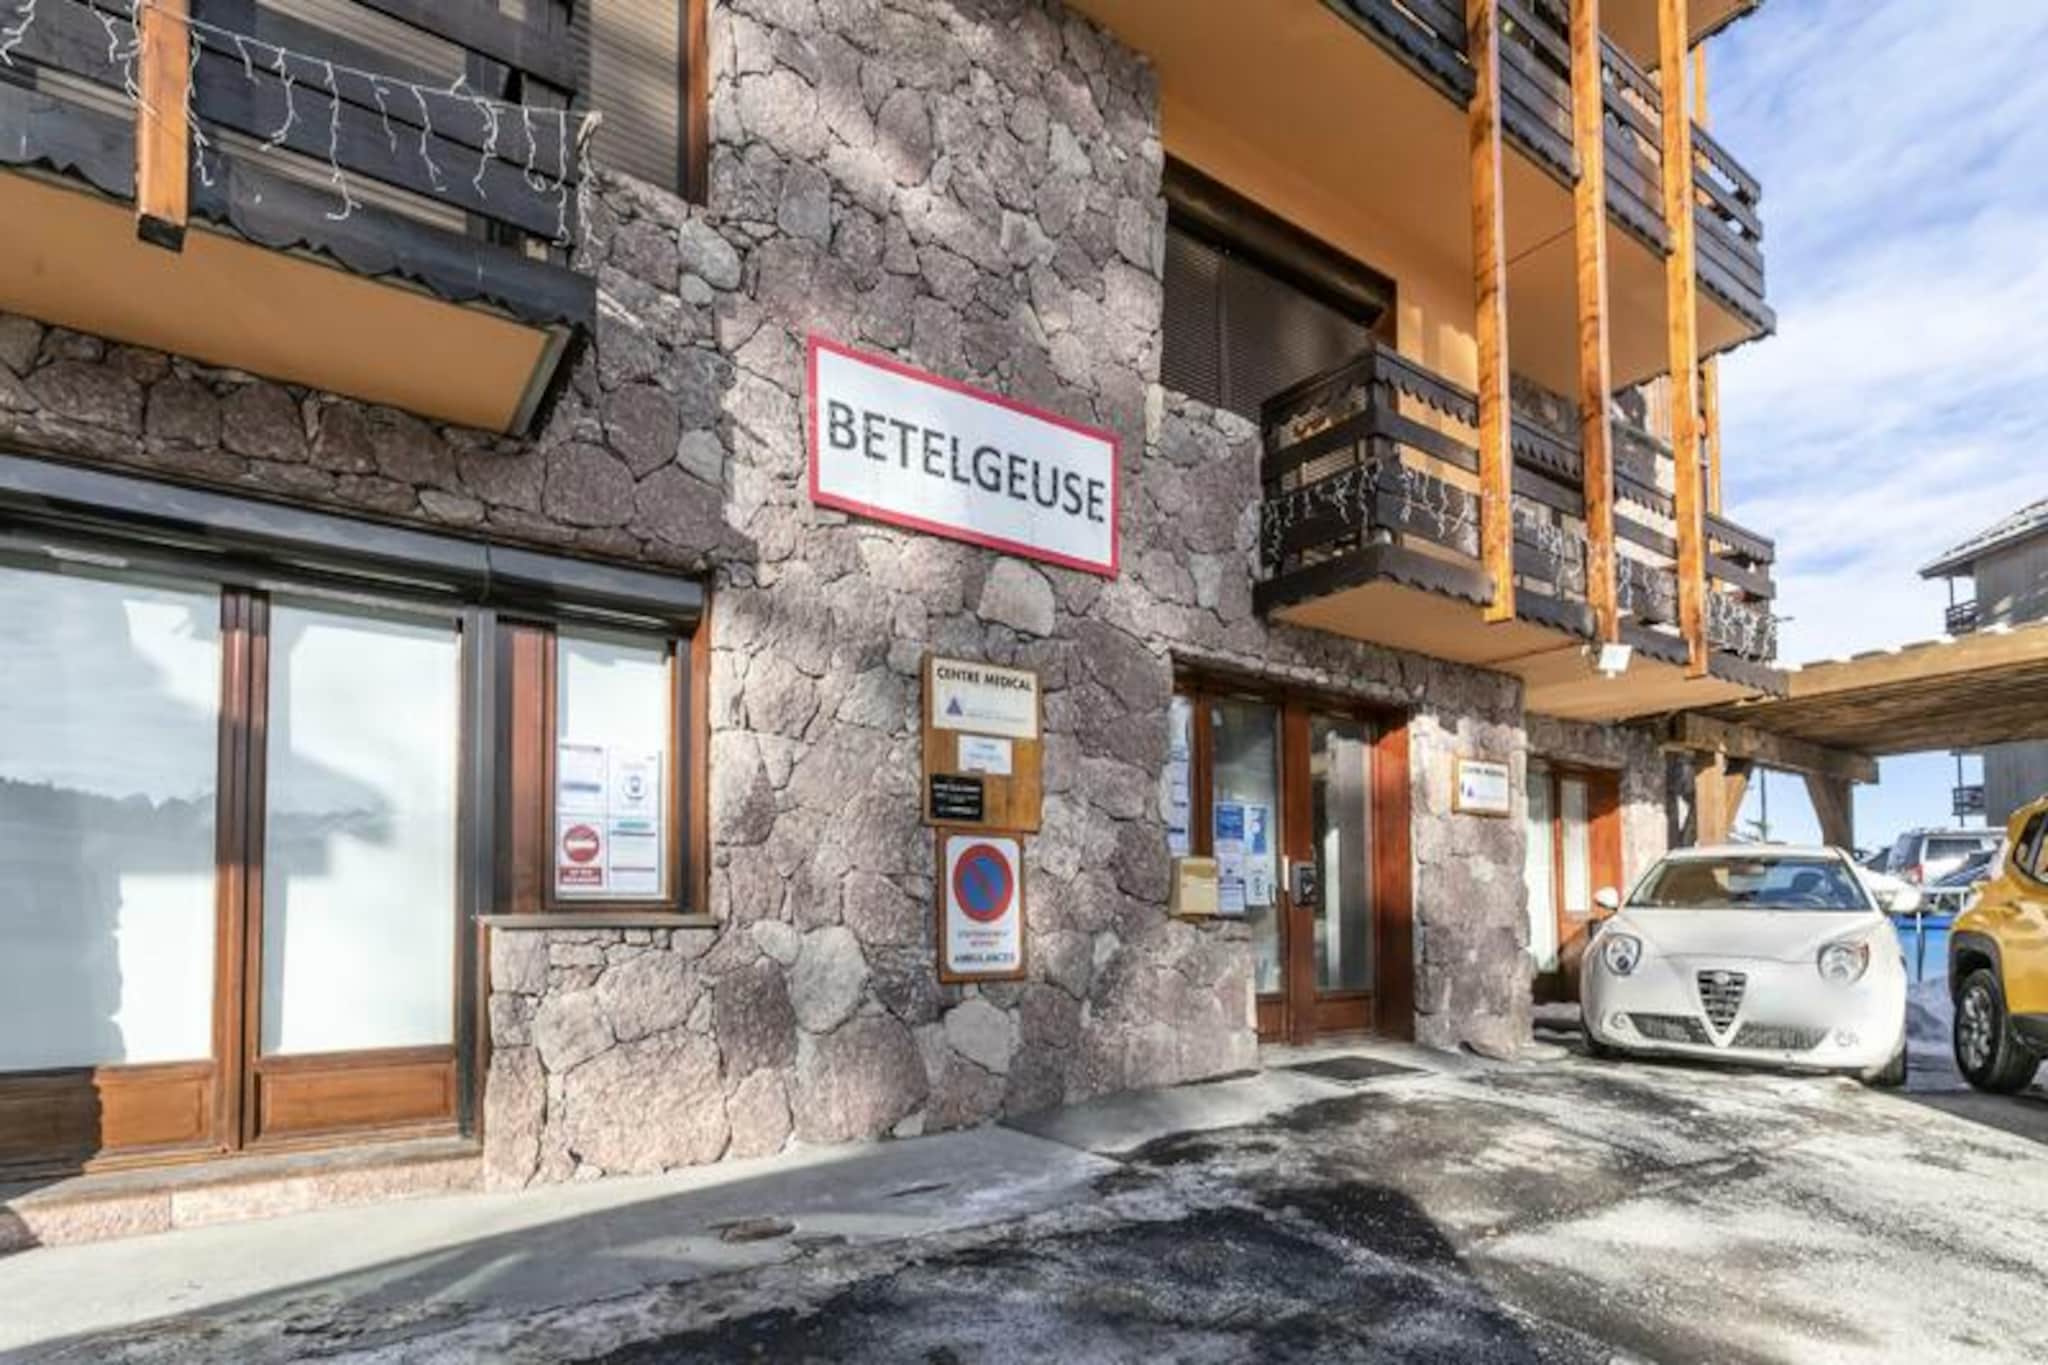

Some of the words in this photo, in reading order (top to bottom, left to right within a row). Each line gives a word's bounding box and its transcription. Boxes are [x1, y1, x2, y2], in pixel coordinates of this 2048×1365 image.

[827, 399, 1106, 523] BETELGEUSE
[936, 667, 979, 683] CENTRE
[984, 673, 1033, 692] MEDICAL
